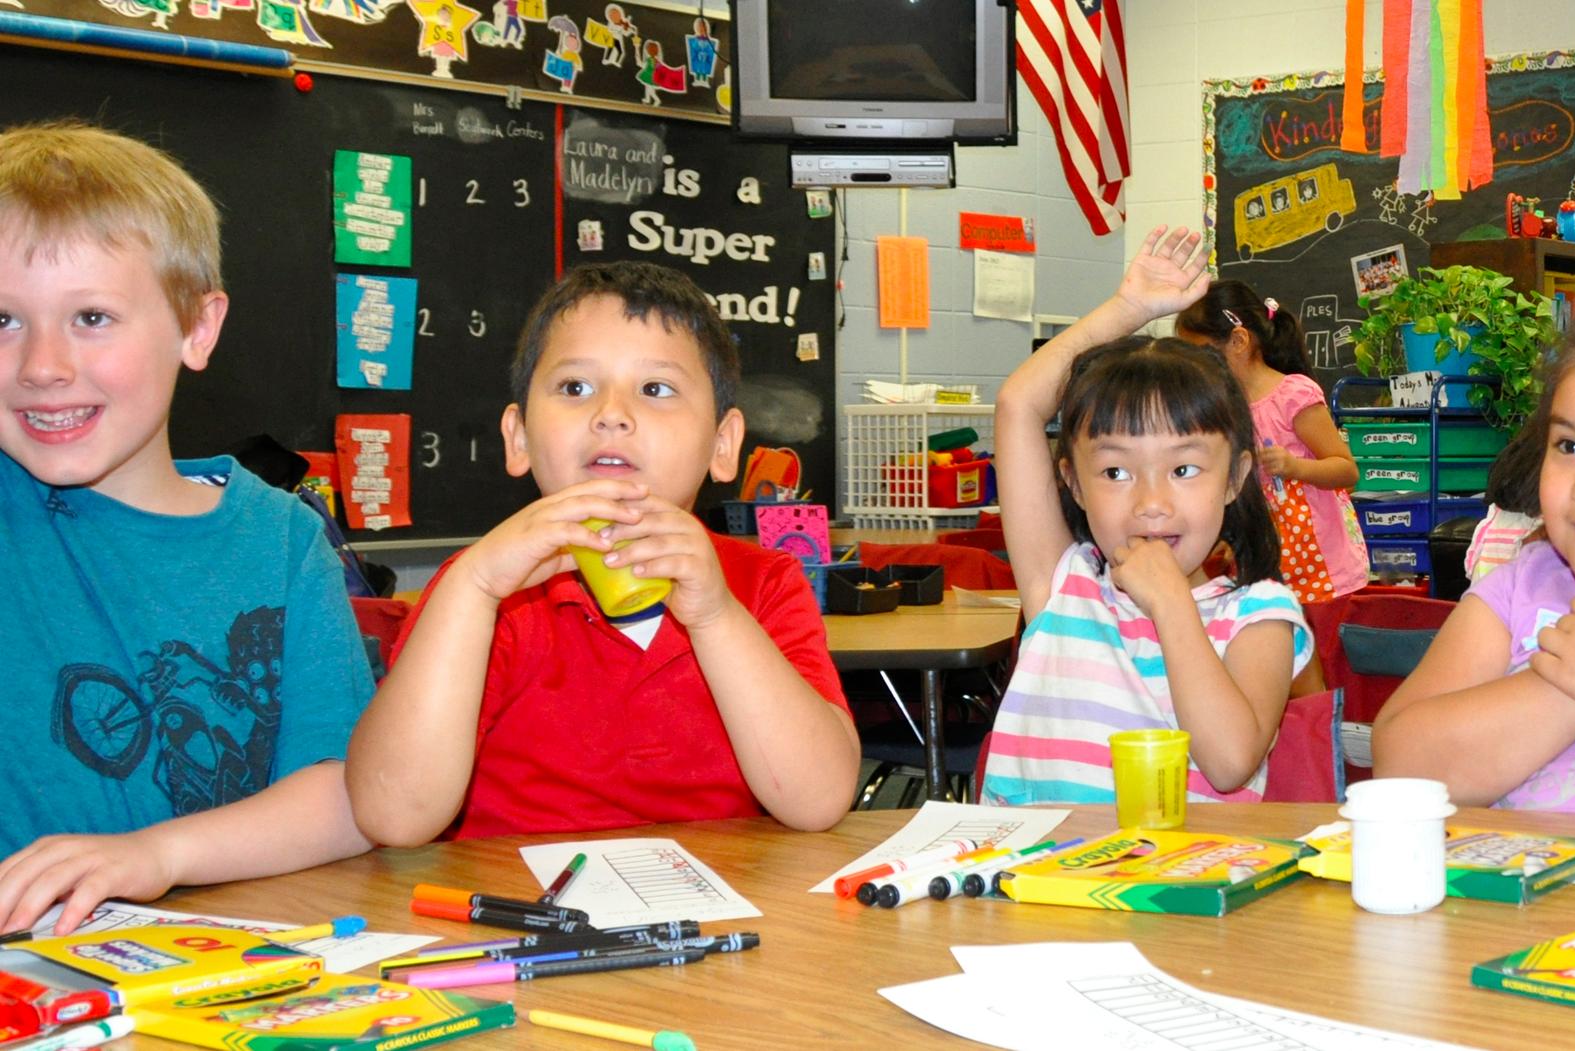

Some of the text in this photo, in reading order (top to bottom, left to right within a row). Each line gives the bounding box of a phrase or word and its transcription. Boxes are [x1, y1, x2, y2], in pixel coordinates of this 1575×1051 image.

[564, 128, 658, 165] Laura and
[465, 178, 487, 206] 2
[512, 178, 531, 207] 3
[570, 158, 654, 202] Madelyn
[662, 154, 762, 205] is a
[628, 210, 776, 265] Super
[960, 222, 1024, 245] Computer
[418, 307, 436, 337] 2
[1306, 304, 1333, 318] PLES
[421, 431, 441, 468] 3
[1363, 433, 1389, 445] green
[1366, 470, 1392, 480] green
[1057, 838, 1138, 868] Crayola
